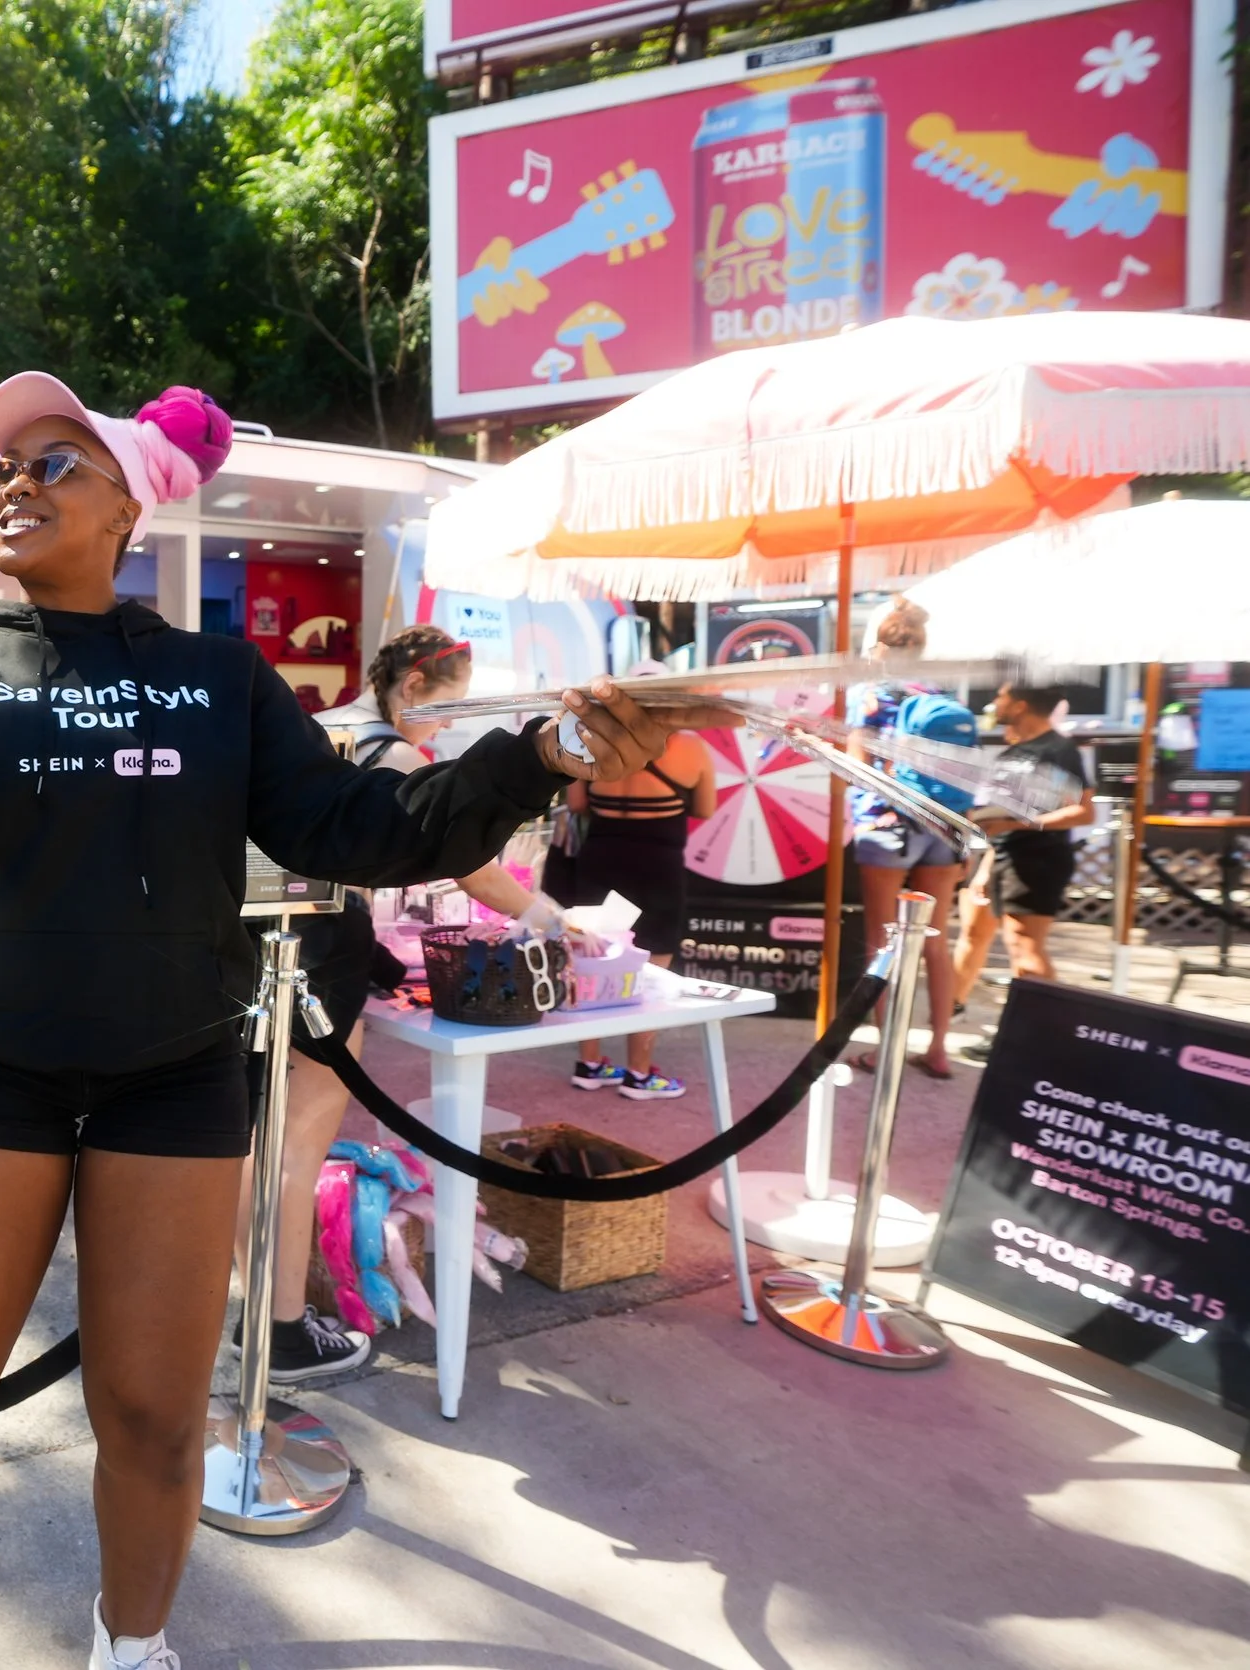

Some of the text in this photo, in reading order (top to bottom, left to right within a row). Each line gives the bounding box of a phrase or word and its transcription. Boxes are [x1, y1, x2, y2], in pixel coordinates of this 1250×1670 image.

[52, 707, 140, 729] Tour
[122, 756, 174, 768] Klana.
[680, 938, 823, 966] Save mone
[688, 918, 745, 932] SHEIN
[731, 963, 755, 986] in
[1075, 1025, 1148, 1052] SHEIN
[1020, 1100, 1105, 1139] SHEIN
[1134, 1132, 1250, 1185] KLARN
[1034, 1081, 1097, 1109] Come
[1098, 1101, 1172, 1131] check
[1174, 1123, 1223, 1145] out
[1011, 1142, 1135, 1196] Wanderlust
[1140, 1184, 1202, 1218] Wine
[1036, 1128, 1234, 1205] SHOWROOM
[1031, 1169, 1209, 1243] Barton Springs.
[991, 1218, 1136, 1287] OCTOBER
[1079, 1283, 1208, 1344] everyday
